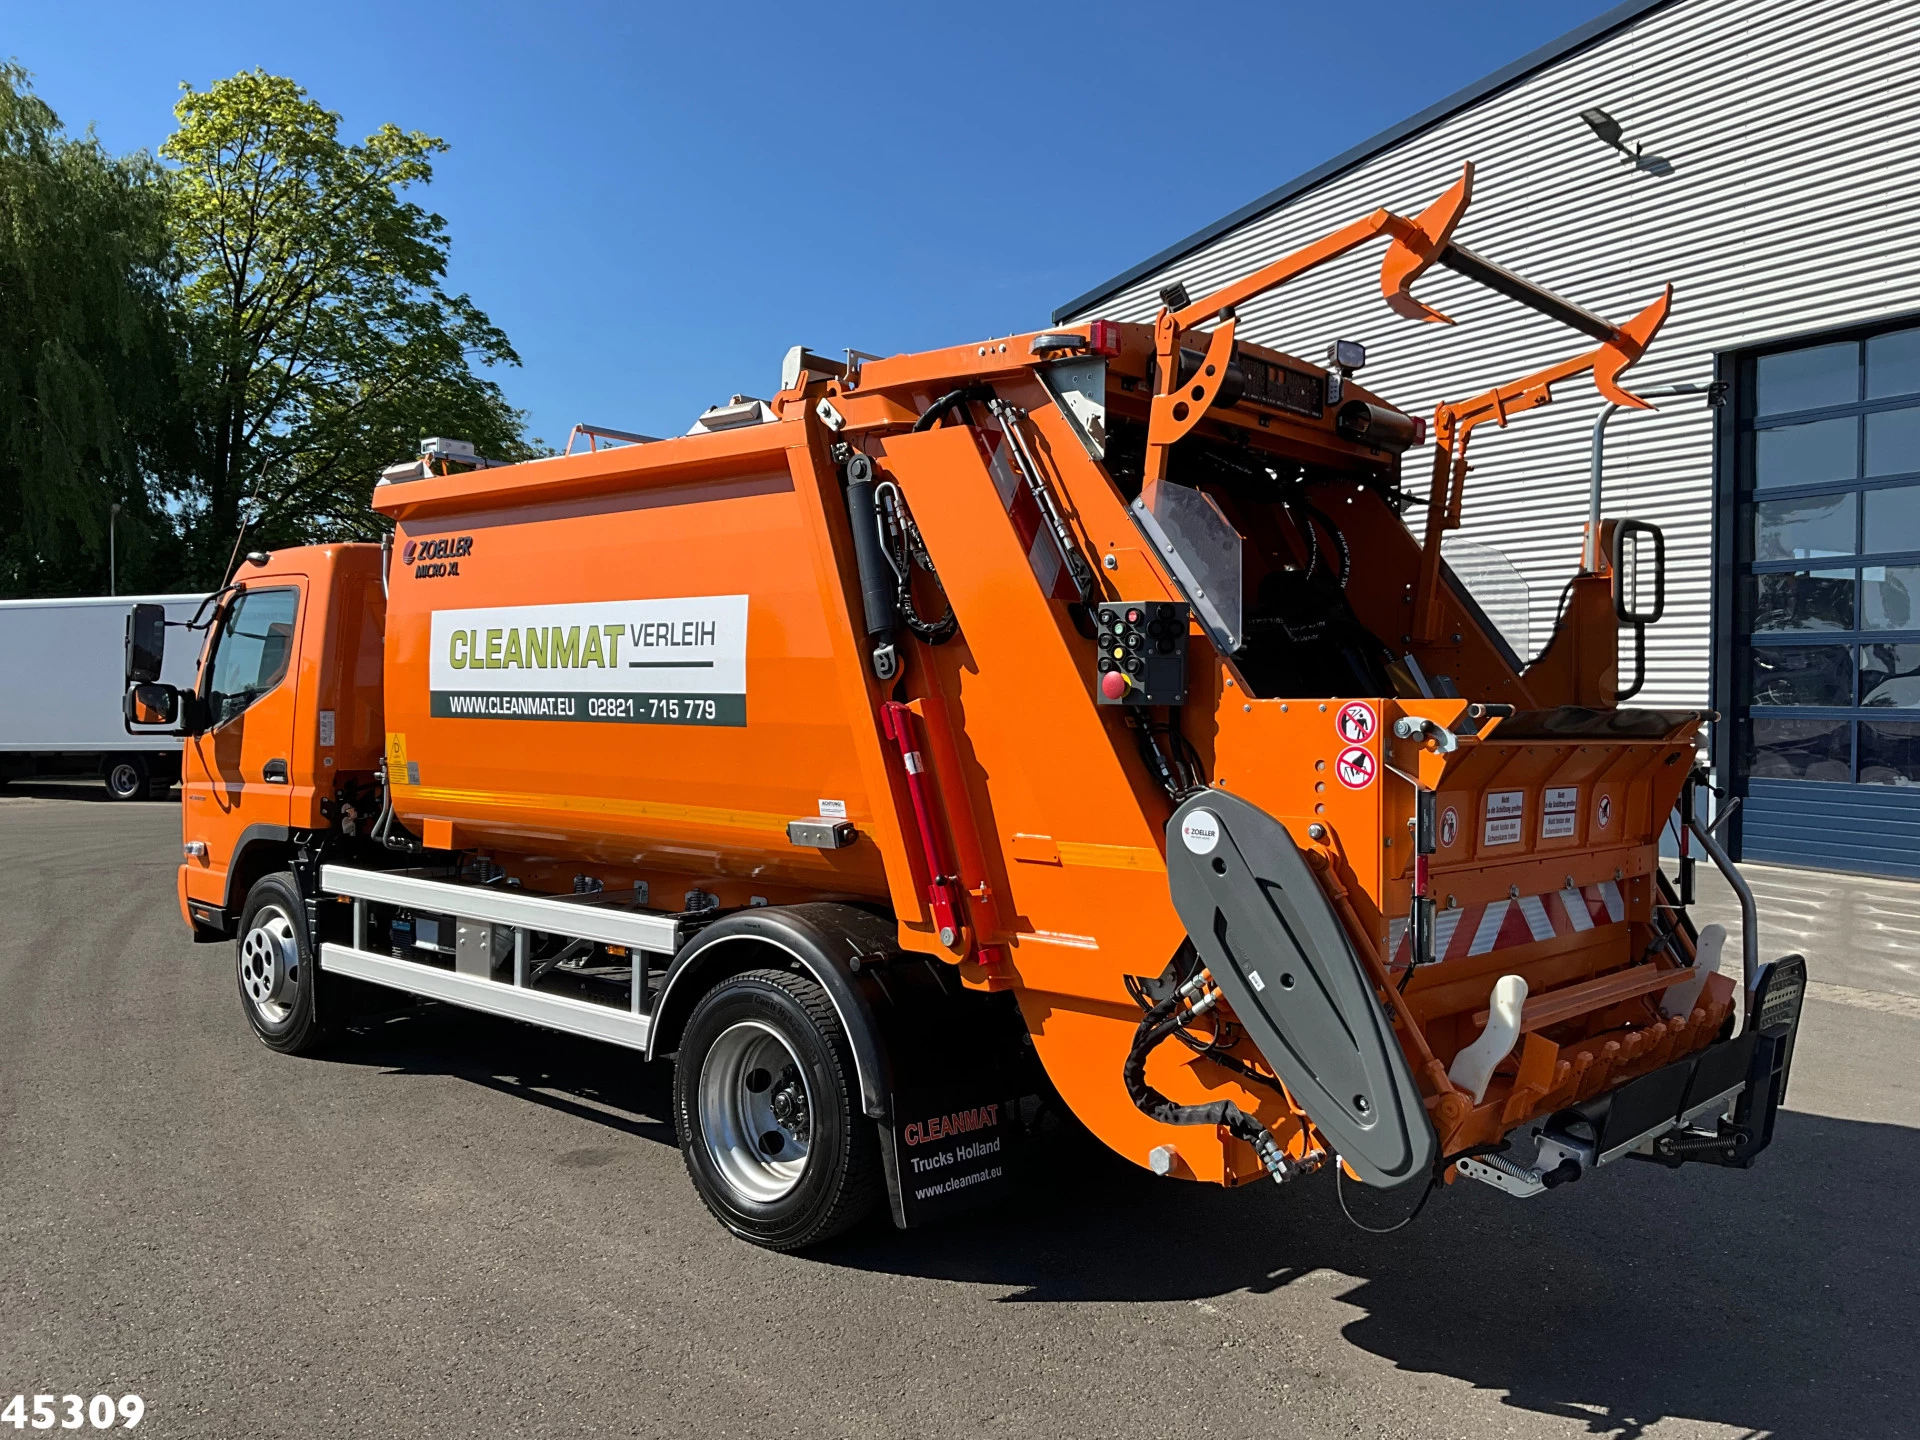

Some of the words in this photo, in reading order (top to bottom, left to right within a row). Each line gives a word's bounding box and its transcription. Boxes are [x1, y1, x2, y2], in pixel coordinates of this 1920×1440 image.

[417, 536, 473, 561] ZOELLER
[415, 562, 447, 579] MICRO
[447, 562, 460, 576] XL
[449, 624, 626, 669] CLEANMAT
[630, 620, 716, 647] VERLEIH
[449, 696, 575, 716] WWW.CLEANMAT.EU
[588, 698, 634, 717] 02821
[650, 699, 679, 719] 715
[685, 700, 716, 720] 779
[1190, 828, 1216, 837] ZOELLER
[904, 1103, 999, 1146] CLEANMAT
[911, 1151, 954, 1173] Trucks
[956, 1137, 1000, 1162] Holland
[915, 1166, 1002, 1200] www.cleanmat.eu
